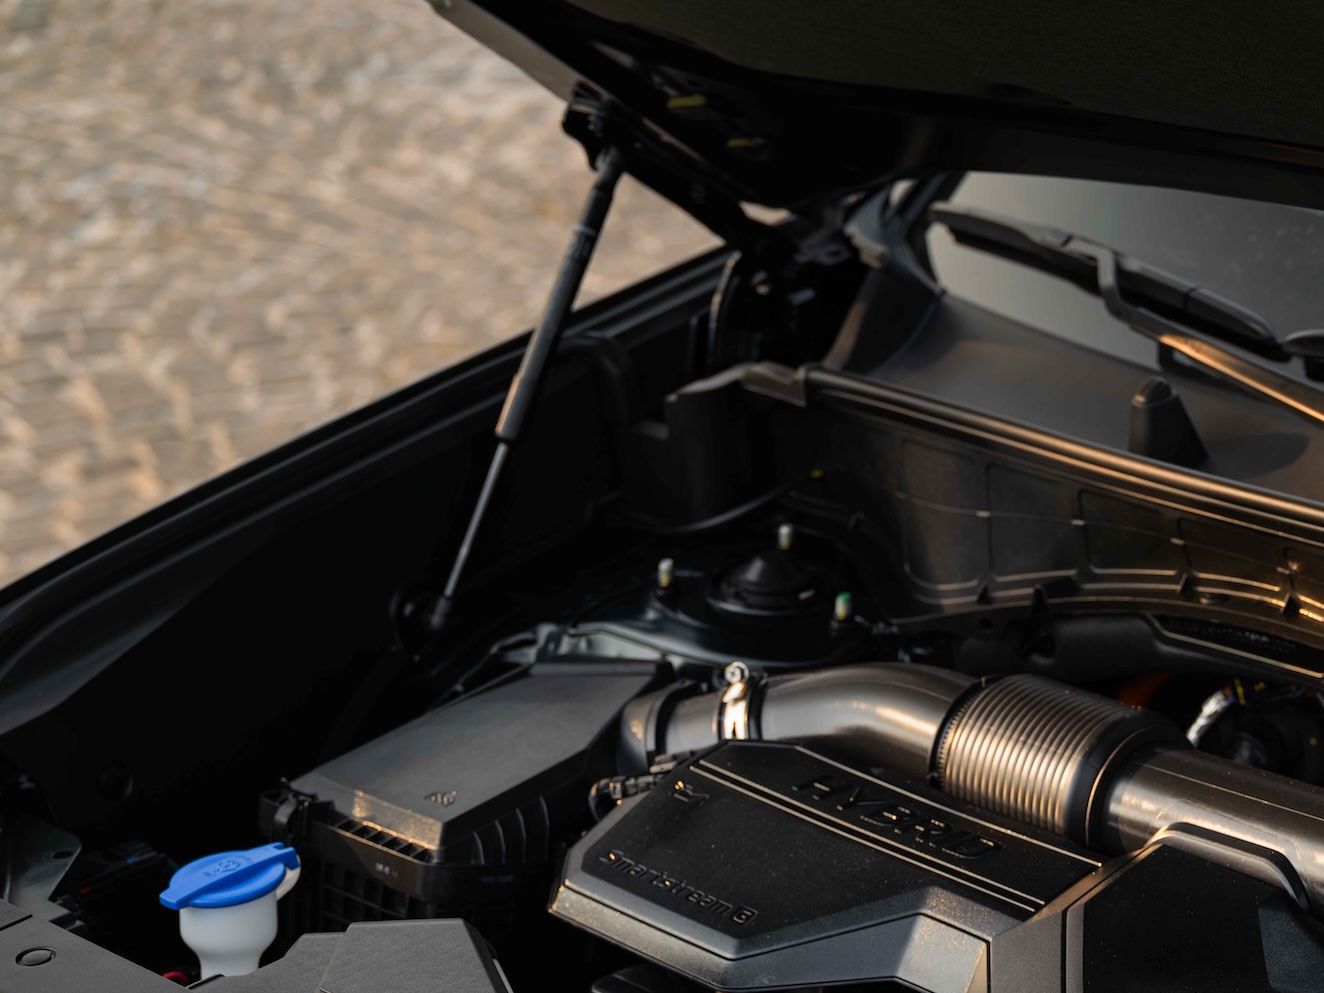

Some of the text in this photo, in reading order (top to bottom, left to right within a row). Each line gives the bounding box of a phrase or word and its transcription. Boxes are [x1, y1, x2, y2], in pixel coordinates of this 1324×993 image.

[792, 776, 1001, 859] HYBRID
[599, 850, 758, 926] Smartstream G
